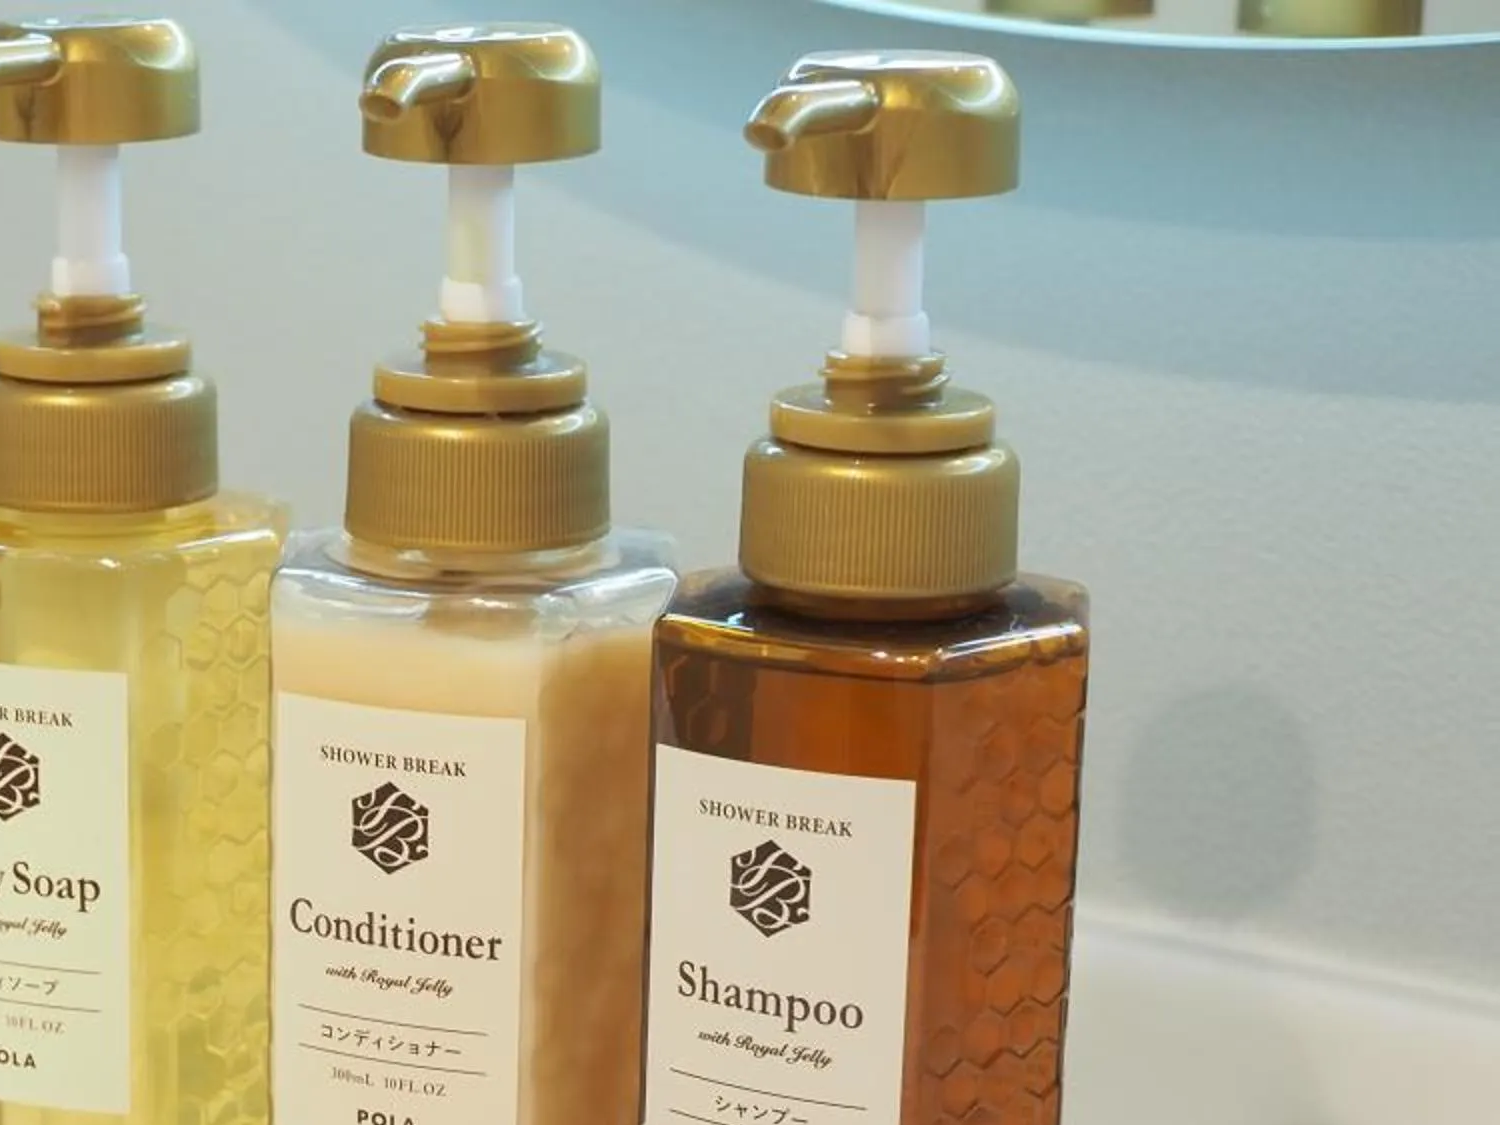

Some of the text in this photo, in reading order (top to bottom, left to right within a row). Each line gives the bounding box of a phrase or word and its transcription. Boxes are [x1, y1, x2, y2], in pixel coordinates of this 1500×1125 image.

[14, 706, 73, 728] BREAK
[319, 744, 467, 778] SHOWER BREAK
[698, 798, 853, 838] SHOWER BREAK
[11, 860, 101, 913] Soap
[26, 917, 68, 939] Jelly
[289, 896, 503, 961] Conditioner
[325, 964, 454, 998] with Royal Jelly
[677, 959, 865, 1034] Shampoo
[319, 1023, 462, 1058] コンディショナー
[697, 1030, 832, 1069] with Royal Jelly
[714, 1094, 809, 1125] シャンプー
